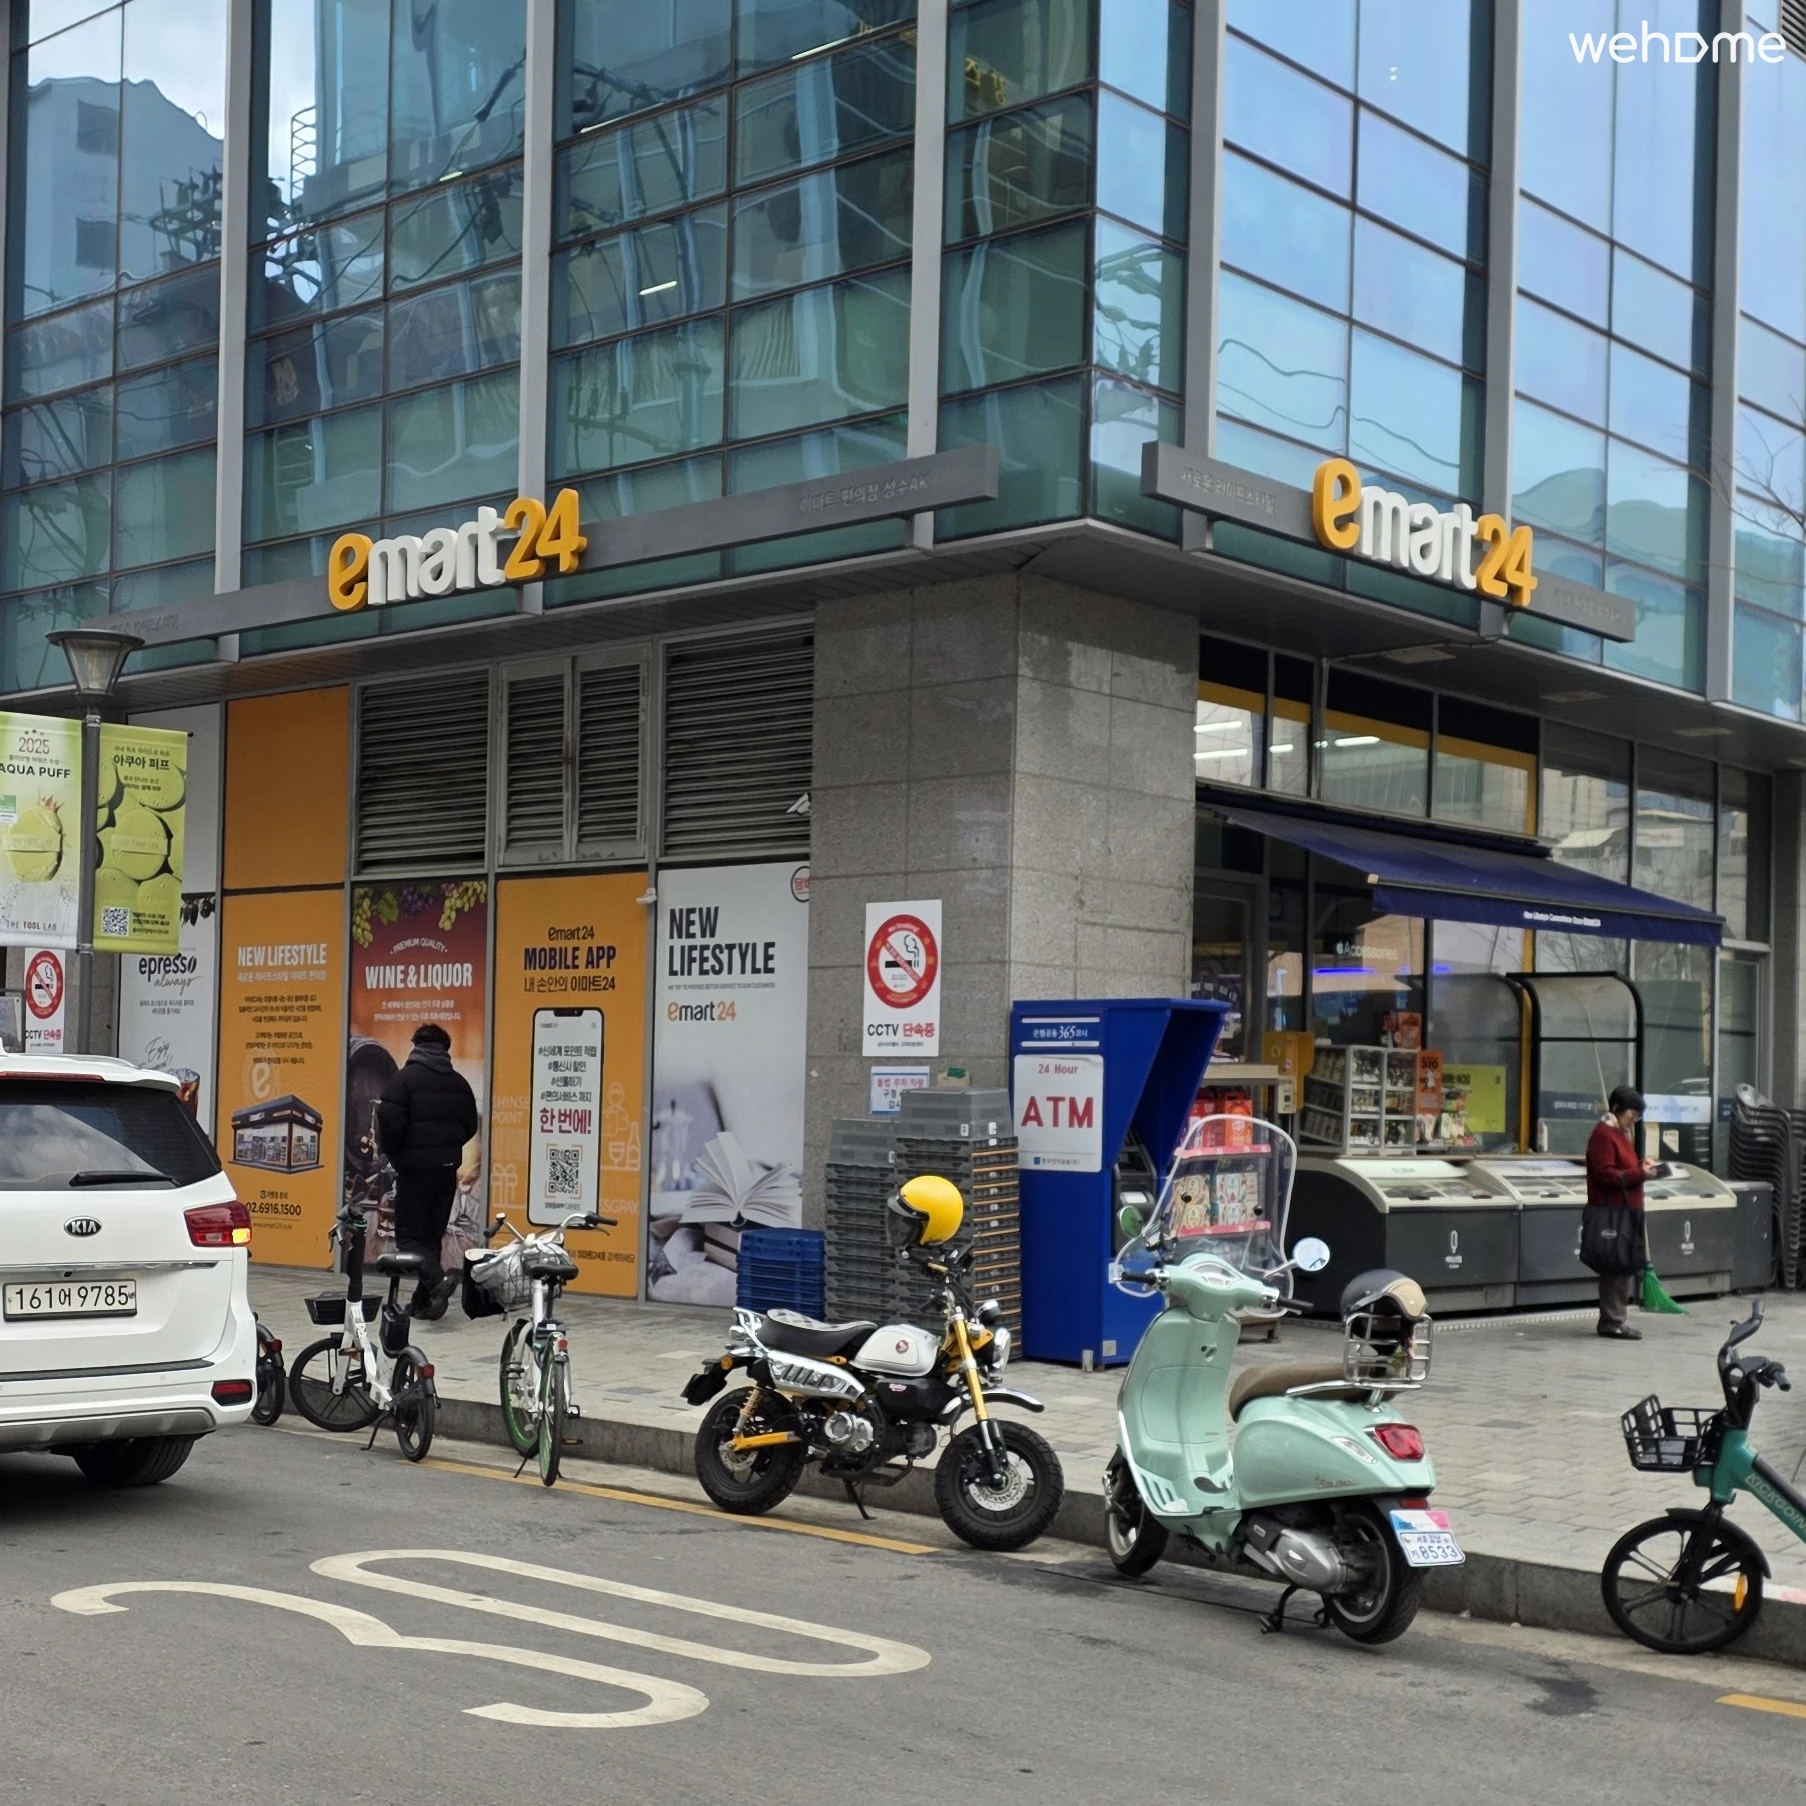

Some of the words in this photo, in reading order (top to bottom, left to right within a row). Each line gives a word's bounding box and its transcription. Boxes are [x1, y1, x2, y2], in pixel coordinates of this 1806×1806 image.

[800, 491, 838, 512] 이마트
[841, 482, 878, 507] 편의점
[1312, 457, 1538, 608] emart24
[328, 488, 587, 612] emart24
[19, 737, 50, 755] 2025
[0, 763, 35, 776] AQUA
[39, 766, 71, 779] PUFF
[113, 754, 146, 769] 아쿠아
[149, 758, 170, 771] 퍼프
[6, 920, 19, 928] THE
[23, 921, 41, 930] TOOL
[43, 922, 57, 931] LAB
[669, 906, 719, 939] NEW
[548, 925, 595, 941] emart24
[393, 938, 420, 954] PREMIUM
[420, 937, 446, 952] QUALITY
[1344, 941, 1398, 960] Accessories
[237, 945, 266, 967] NEW
[267, 943, 328, 966] LIFESTYLE
[524, 946, 580, 970] MOBILE
[585, 945, 617, 969] APP
[668, 941, 776, 976] LIFESTYLE
[154, 973, 202, 996] always
[365, 965, 405, 989] WINE
[420, 963, 473, 990] LIQUOR
[524, 976, 535, 992] 내
[537, 976, 568, 993] 손안의
[570, 975, 616, 992] 이마트24
[667, 1001, 737, 1022] emart24
[867, 1024, 899, 1036] CCTV
[902, 1022, 935, 1037] 단속중
[563, 1045, 583, 1057] 포인트
[573, 1061, 587, 1072] 할인
[1038, 1063, 1050, 1074] 24
[1054, 1063, 1079, 1074] Hour
[550, 1076, 582, 1088] #선물하기
[539, 1107, 556, 1133] 한
[558, 1108, 592, 1134] 번에!
[1021, 1095, 1094, 1129] ATM
[245, 1202, 302, 1215] 02.6916.1500
[71, 1220, 97, 1233] KIA
[1745, 1473, 1806, 1536] KICKGOIN
[1419, 1545, 1458, 1560] 8533
